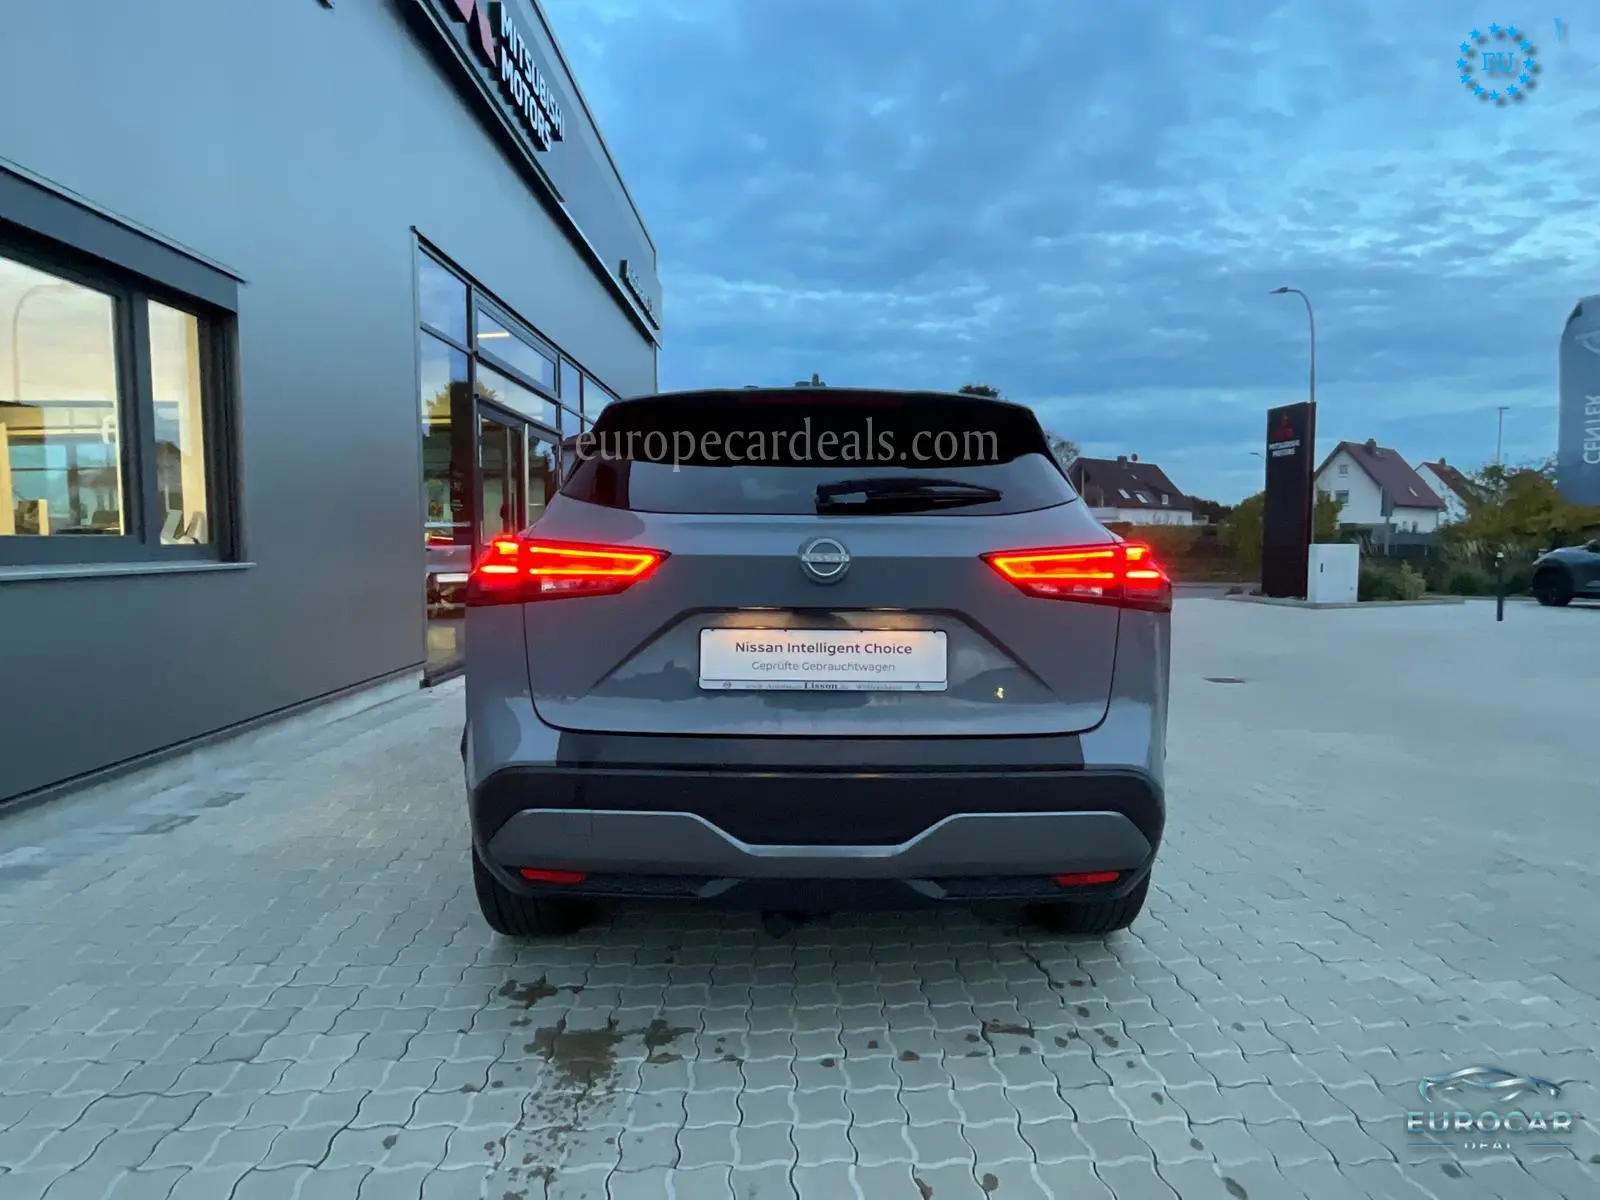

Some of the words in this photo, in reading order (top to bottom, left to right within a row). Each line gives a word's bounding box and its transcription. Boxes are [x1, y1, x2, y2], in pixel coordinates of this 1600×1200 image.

[500, 2, 565, 142] MITSUBISHI
[501, 45, 551, 152] MOTORS
[735, 642, 783, 653] Nissan
[787, 642, 860, 656] Intelligent
[864, 643, 912, 654] Choice
[801, 661, 895, 673] Gebrauchtwagen
